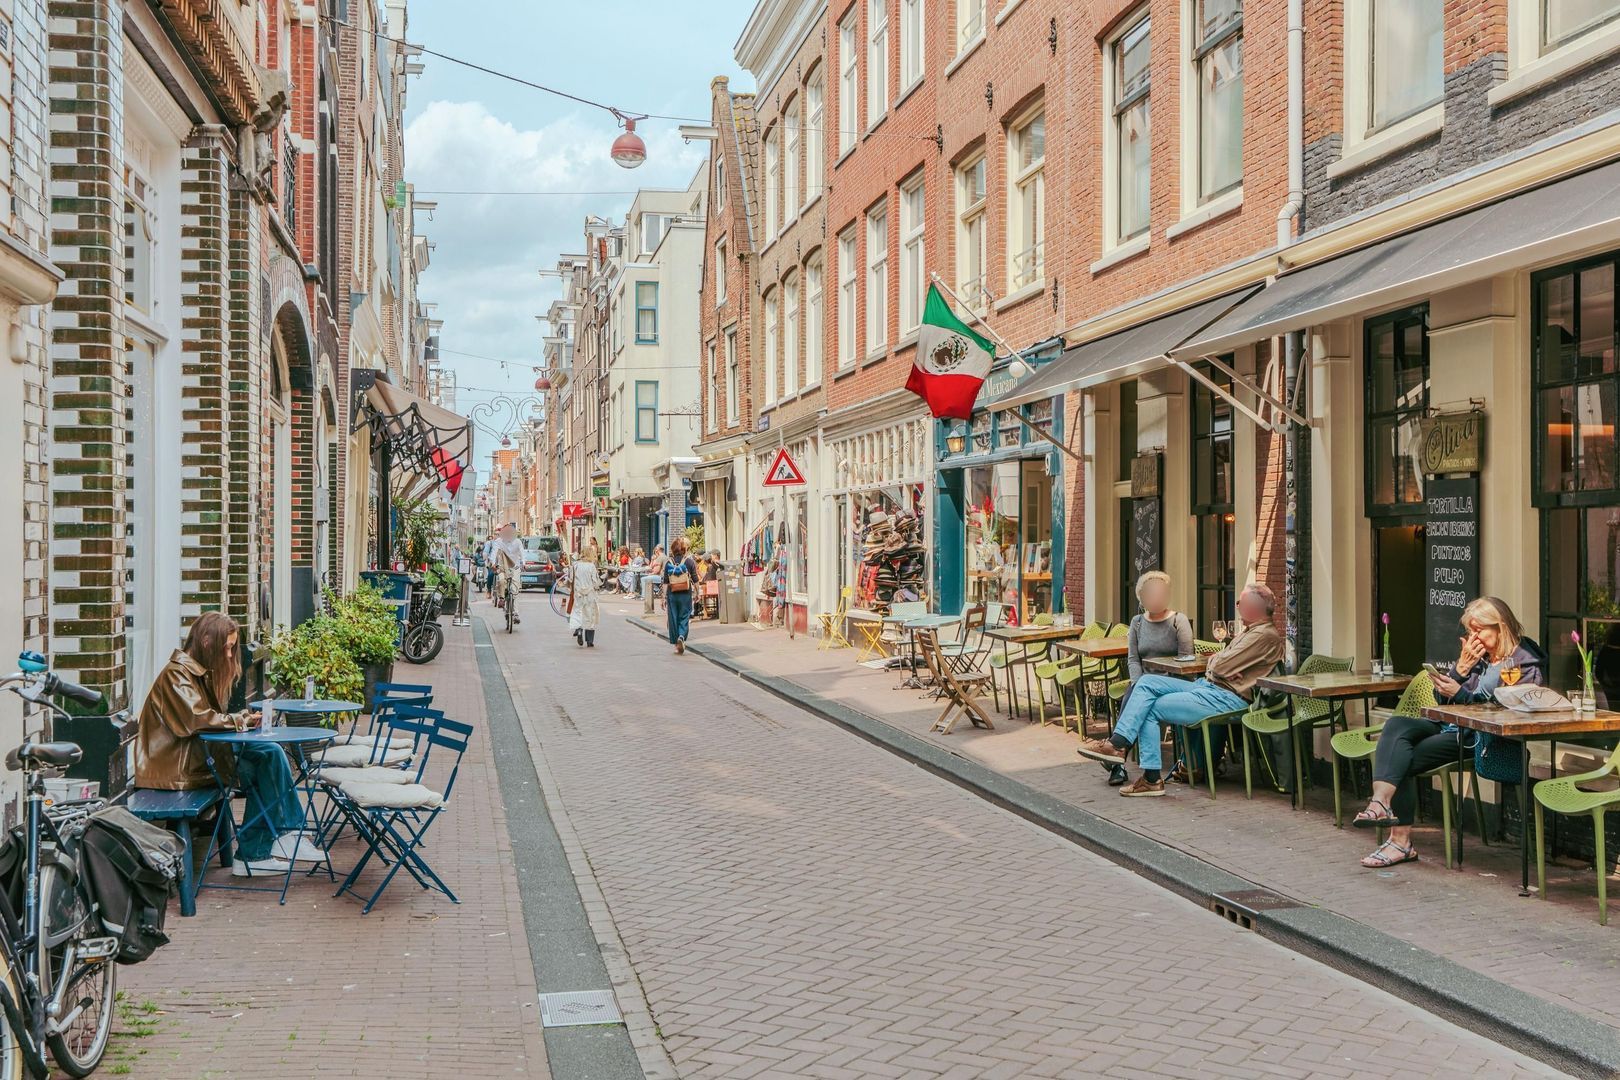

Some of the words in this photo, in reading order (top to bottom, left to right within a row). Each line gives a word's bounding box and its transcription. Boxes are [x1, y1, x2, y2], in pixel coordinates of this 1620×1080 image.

[1427, 496, 1474, 514] TORTILLA
[1431, 544, 1472, 561] PINTXOS
[1433, 567, 1464, 585] PULPO
[1429, 588, 1466, 609] POSTRES
